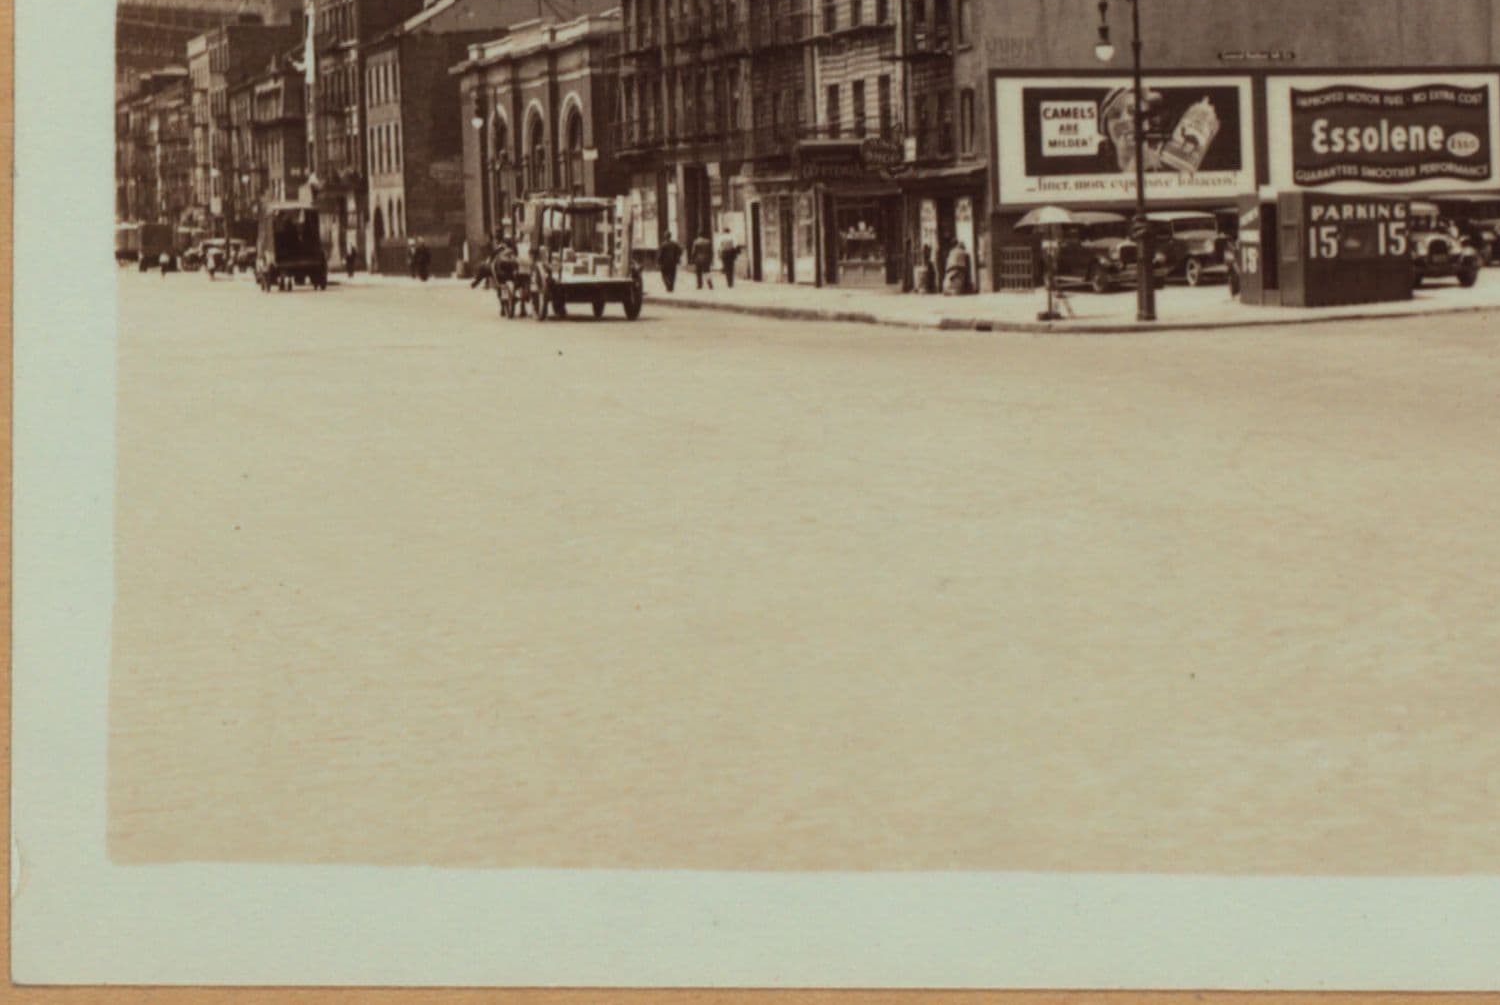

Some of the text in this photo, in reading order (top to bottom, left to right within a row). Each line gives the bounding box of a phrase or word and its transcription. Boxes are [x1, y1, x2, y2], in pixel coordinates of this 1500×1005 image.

[1346, 91, 1380, 105] MOTOR
[1384, 94, 1404, 106] FUEL
[1413, 92, 1426, 103] NO
[1429, 89, 1455, 101] EXTRA
[1458, 92, 1483, 106] COST
[1042, 107, 1095, 120] CAMELS
[1059, 123, 1078, 133] ARE
[1312, 118, 1444, 154] Essolene
[1361, 166, 1416, 179] SMOOTHER
[1310, 203, 1407, 221] PARKING
[1308, 221, 1407, 259] 15 15
